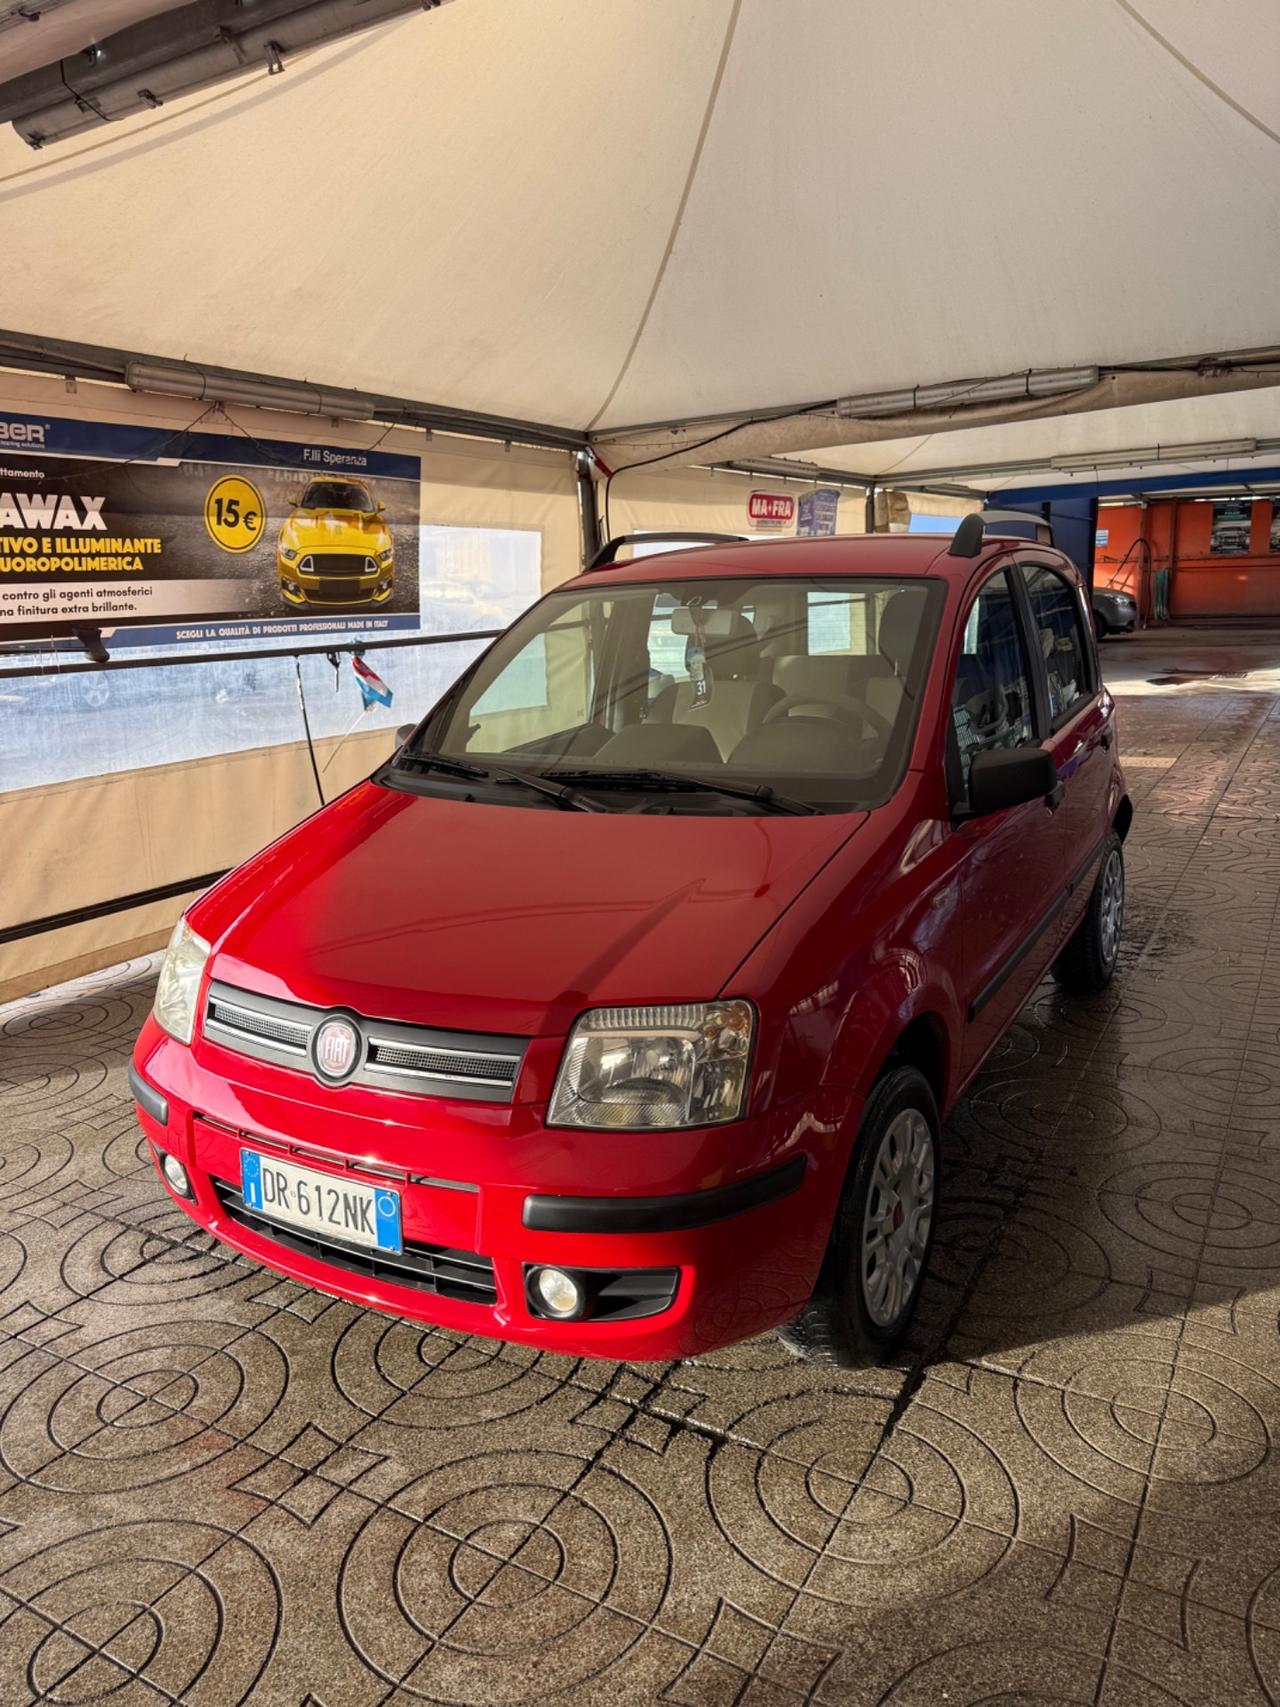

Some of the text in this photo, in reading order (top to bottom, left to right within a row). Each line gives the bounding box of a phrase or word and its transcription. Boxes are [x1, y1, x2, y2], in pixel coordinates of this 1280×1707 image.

[323, 450, 367, 466] Speranza
[0, 492, 108, 530] AWAX
[42, 537, 52, 553] E
[55, 537, 162, 553] ILLUMINANTE
[2, 585, 153, 602] contro gli agenti atmosferici
[17, 604, 58, 616] finitura
[61, 602, 89, 614] extra
[91, 601, 137, 613] brillante.
[176, 620, 388, 640] SCEGLI LA QUALITÀ DI PRODOTTI PROFESSIONALI MADE IN ITALY
[697, 681, 706, 696] 31
[325, 1036, 350, 1063] FIAT
